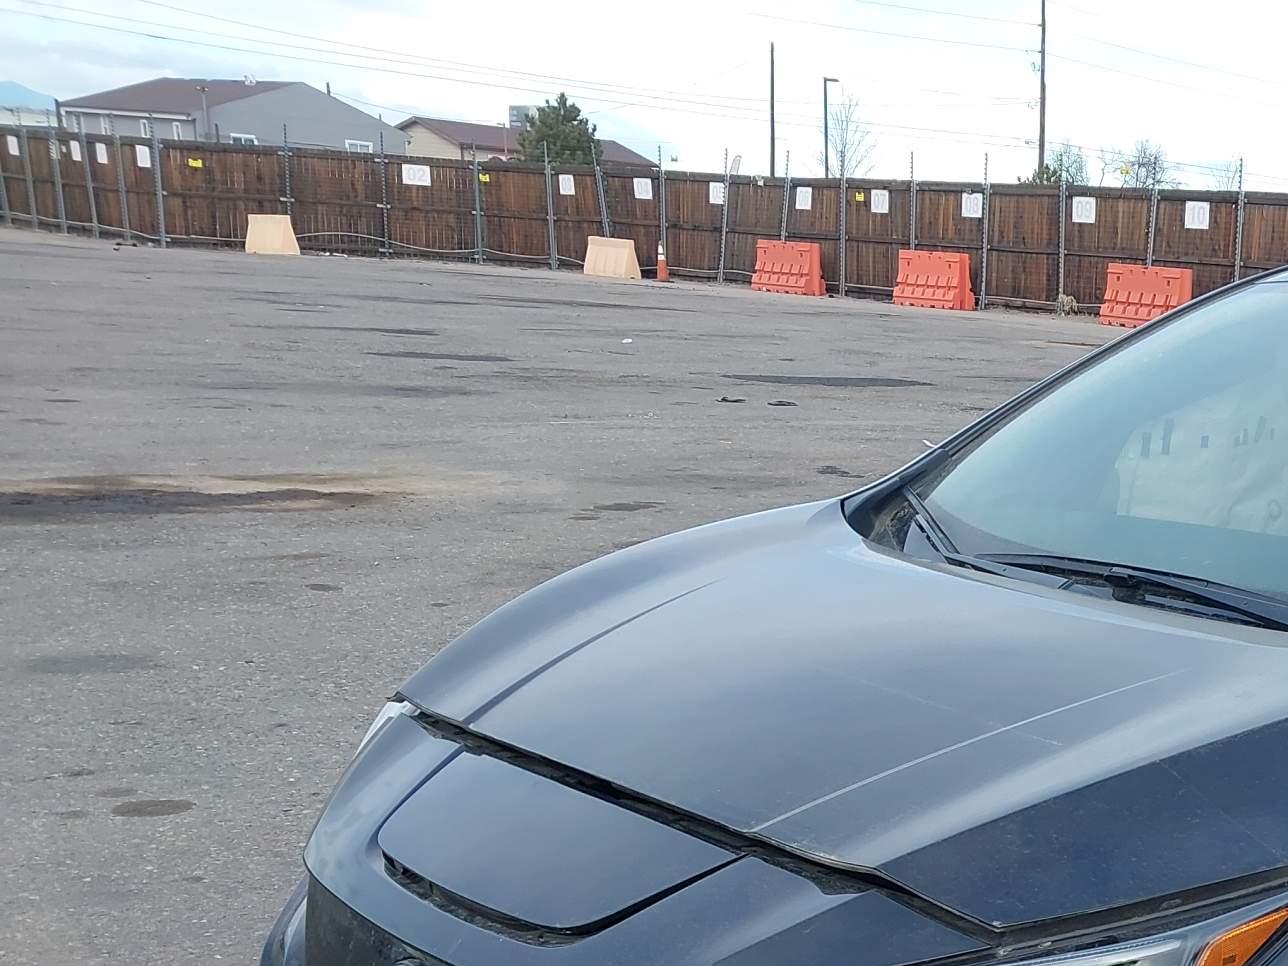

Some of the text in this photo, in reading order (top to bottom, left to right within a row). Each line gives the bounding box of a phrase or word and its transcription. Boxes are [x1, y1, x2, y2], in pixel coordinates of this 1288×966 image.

[407, 169, 425, 182] 02
[873, 191, 886, 210] 07
[1190, 206, 1207, 225] 10
